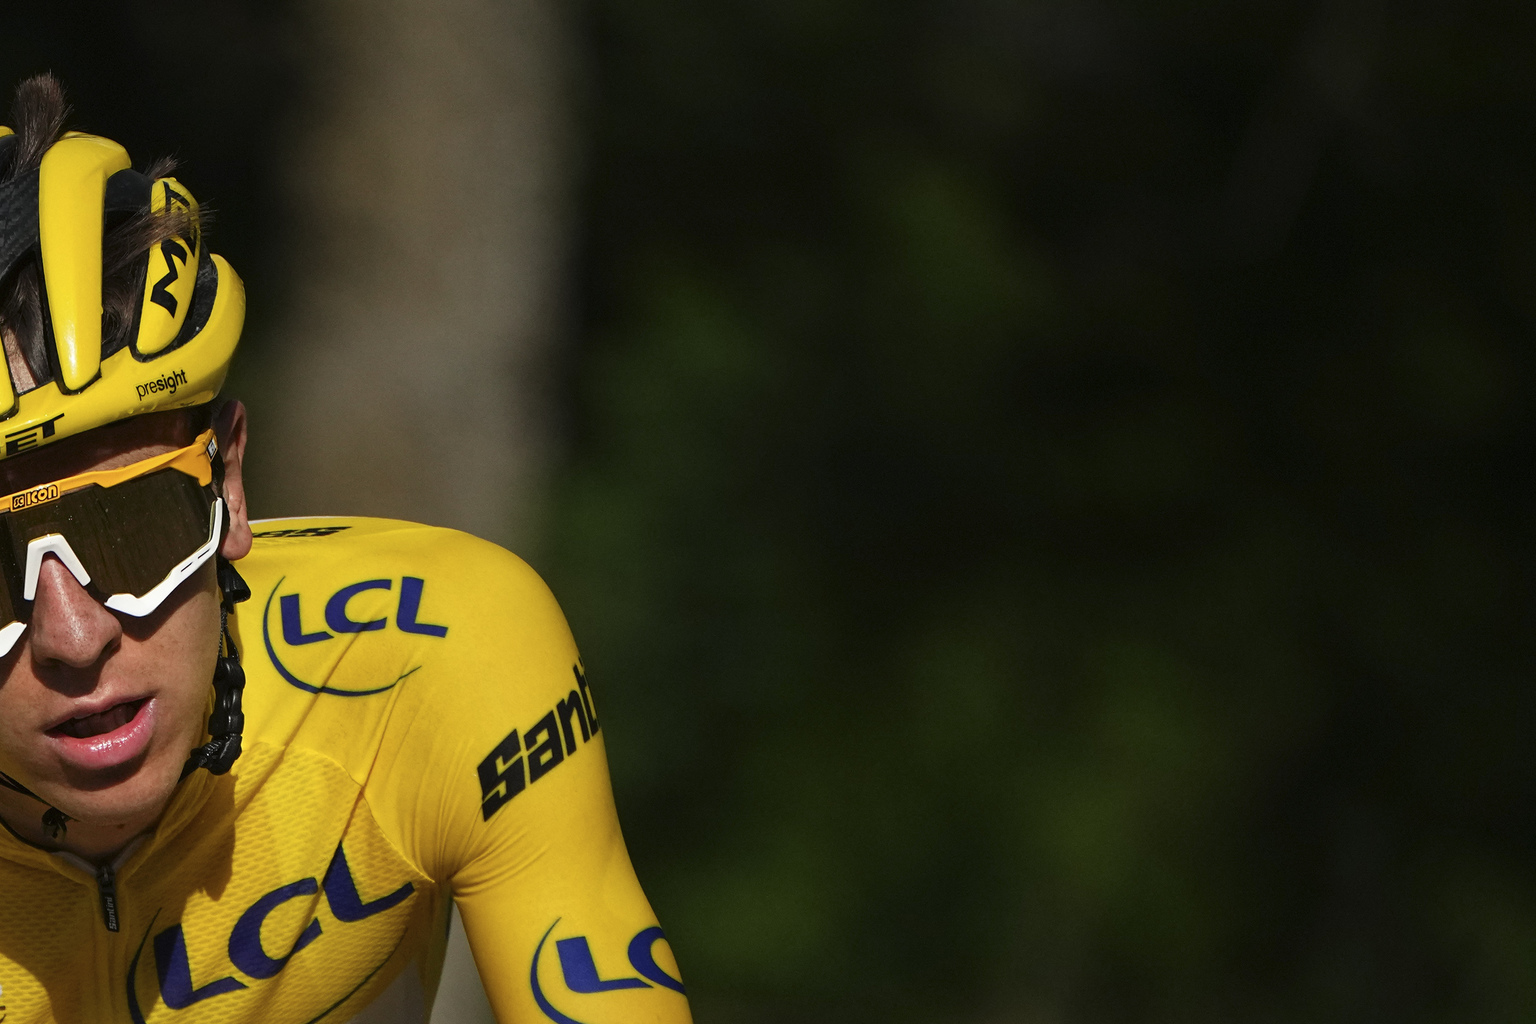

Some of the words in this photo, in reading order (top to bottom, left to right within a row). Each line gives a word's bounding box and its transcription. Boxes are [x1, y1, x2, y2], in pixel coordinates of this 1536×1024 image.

[135, 369, 188, 400] presight
[280, 576, 449, 646] LCL
[477, 655, 602, 822] Sant
[153, 841, 415, 1010] LCL
